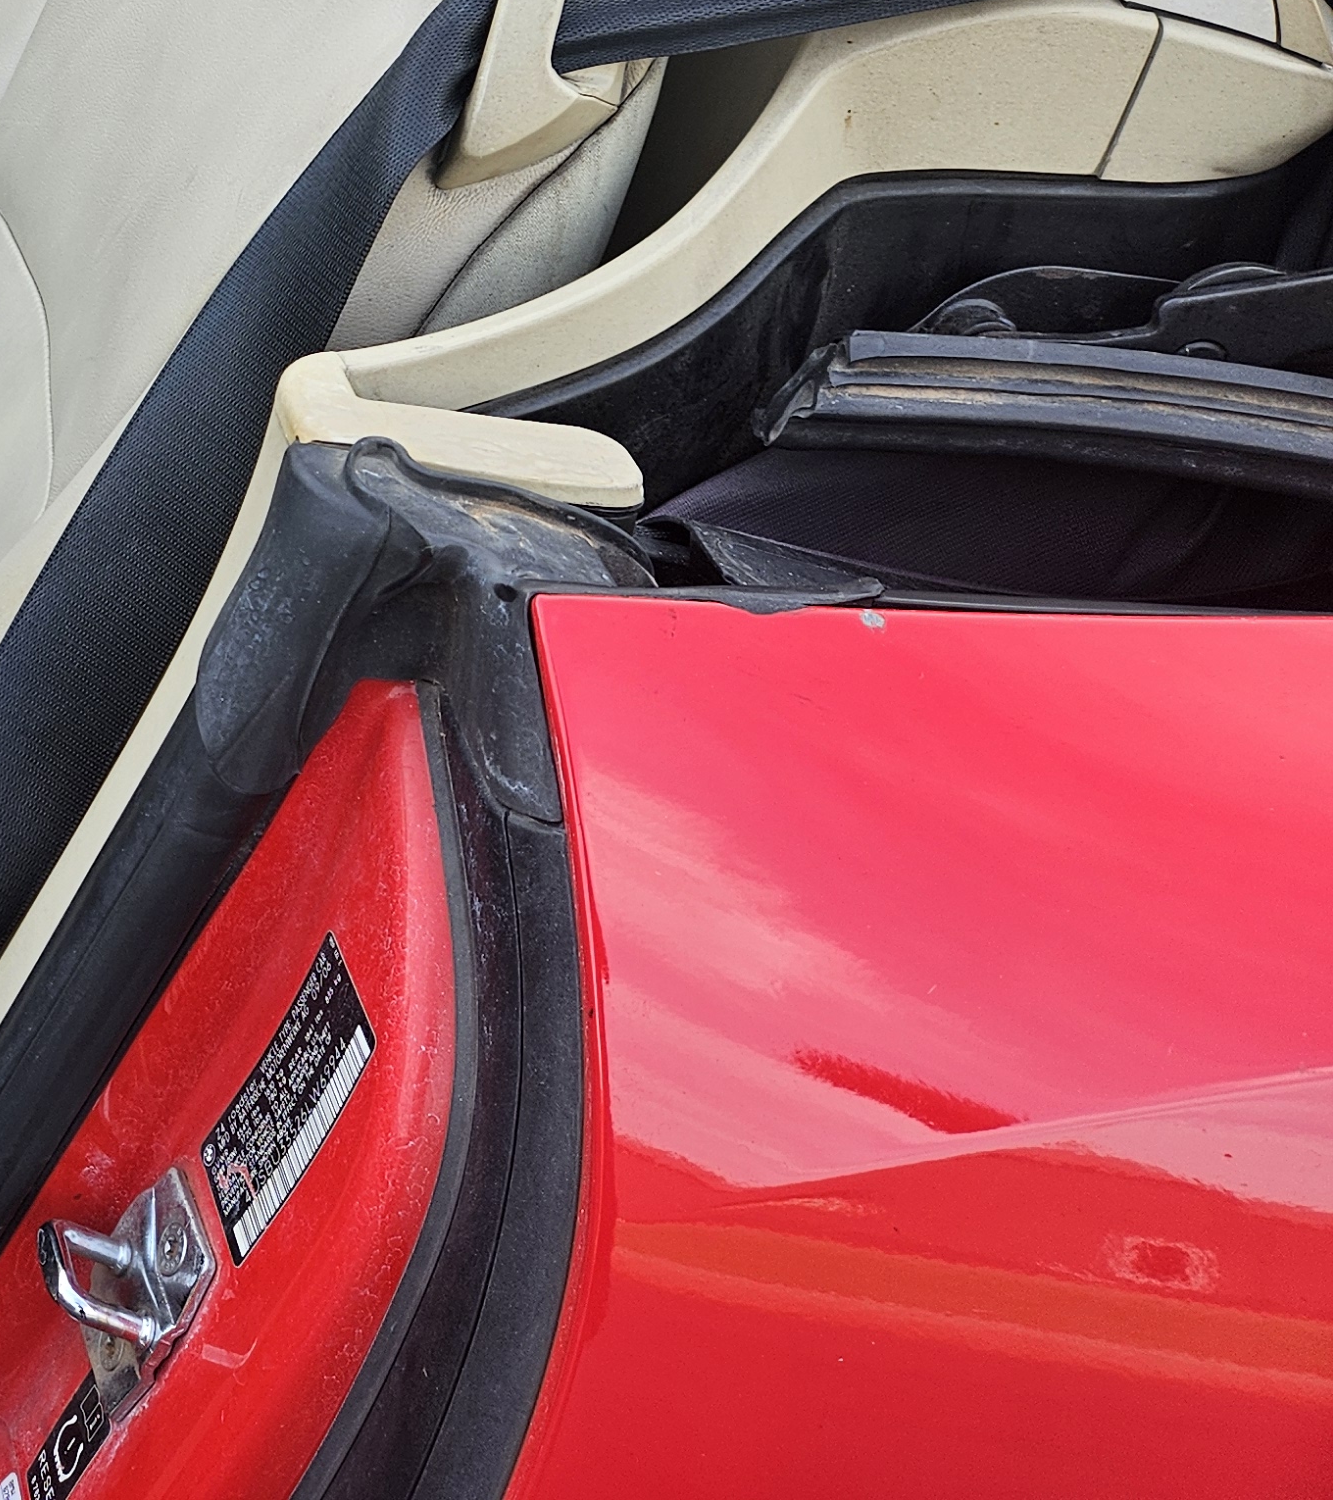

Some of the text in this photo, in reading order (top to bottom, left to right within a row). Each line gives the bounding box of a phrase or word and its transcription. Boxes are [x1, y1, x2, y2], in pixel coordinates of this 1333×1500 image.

[309, 961, 331, 1000] 09/06
[228, 1079, 256, 1128] roadster
[38, 1449, 56, 1500] RESE
